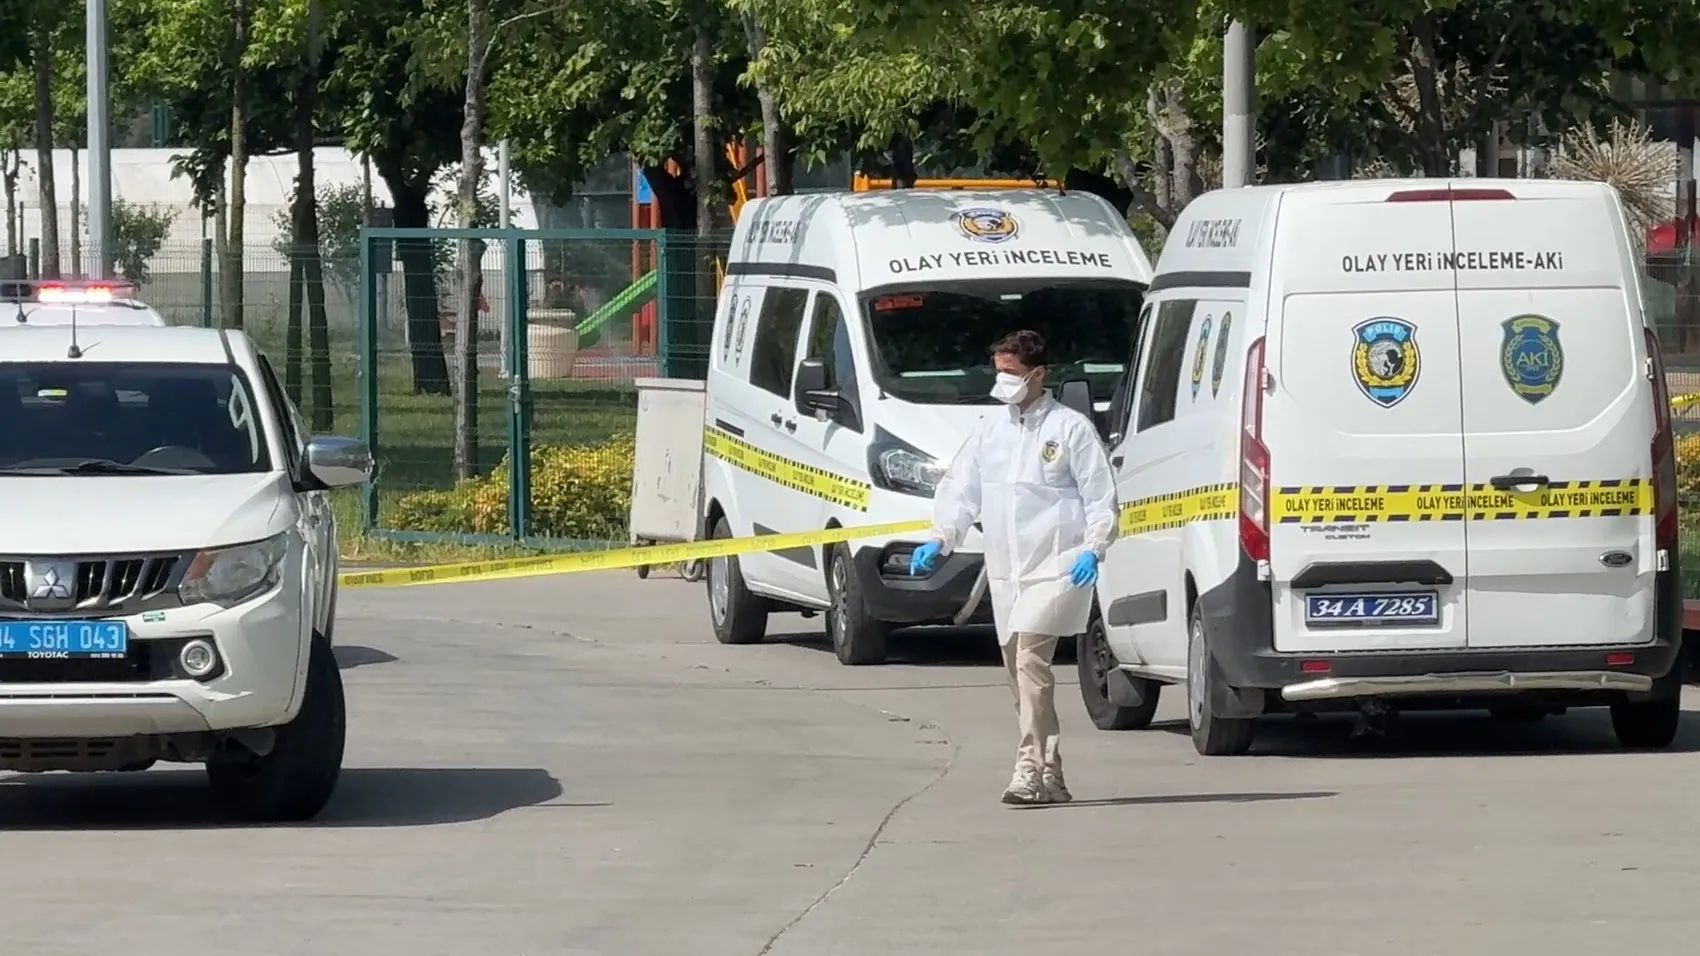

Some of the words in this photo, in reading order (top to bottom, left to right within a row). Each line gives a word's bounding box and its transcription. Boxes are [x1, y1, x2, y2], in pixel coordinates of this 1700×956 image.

[889, 254, 942, 274] OLAY
[1342, 255, 1387, 272] OLAY
[1286, 498, 1311, 512] OLAY
[1416, 497, 1442, 510] OLAY
[1541, 493, 1566, 507] OLAY
[1312, 599, 1342, 617] 34
[1344, 598, 1366, 616] A
[1371, 596, 1430, 616] 7285
[29, 625, 69, 649] SGH
[80, 625, 119, 649] 043
